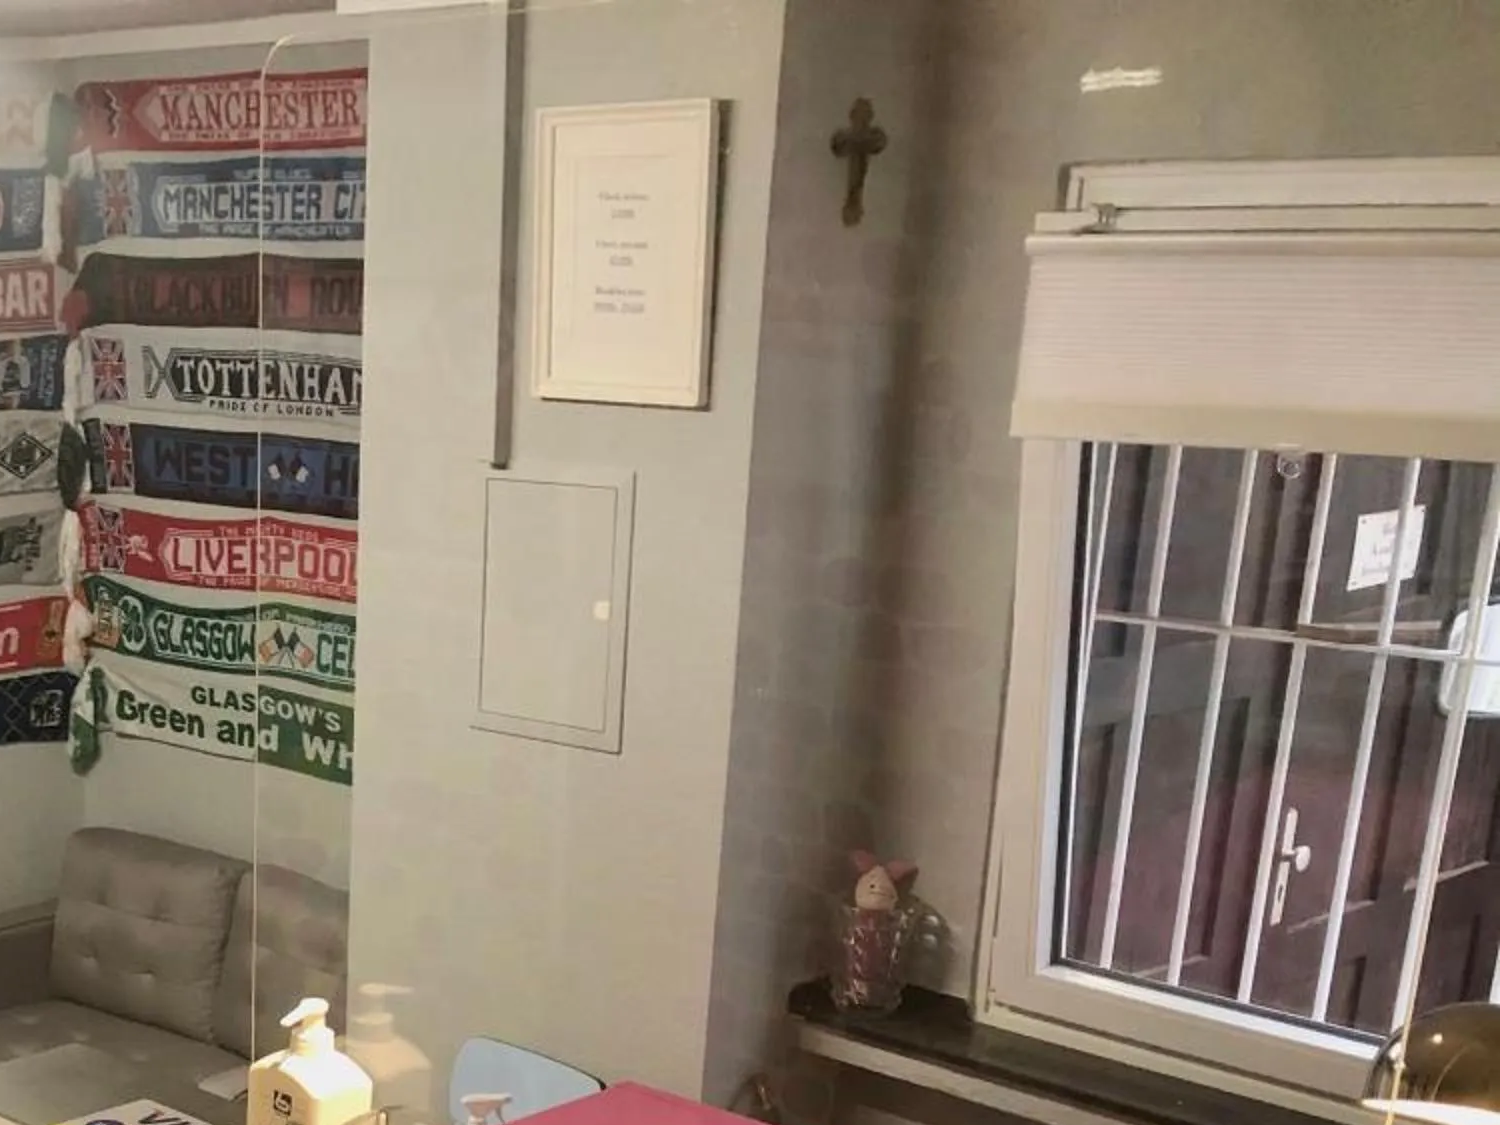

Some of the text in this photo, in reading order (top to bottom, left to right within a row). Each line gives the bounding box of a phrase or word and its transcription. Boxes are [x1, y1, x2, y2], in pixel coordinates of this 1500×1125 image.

[159, 89, 360, 131] MANCHESTER
[162, 183, 323, 221] MANCHESTER
[209, 399, 247, 413] PRIDE
[276, 402, 335, 417] LONDON
[154, 438, 258, 488] WEST
[153, 612, 256, 662] GLASGOW
[115, 688, 206, 739] Green
[216, 717, 280, 754] and
[190, 685, 343, 733] GLASGOW'S
